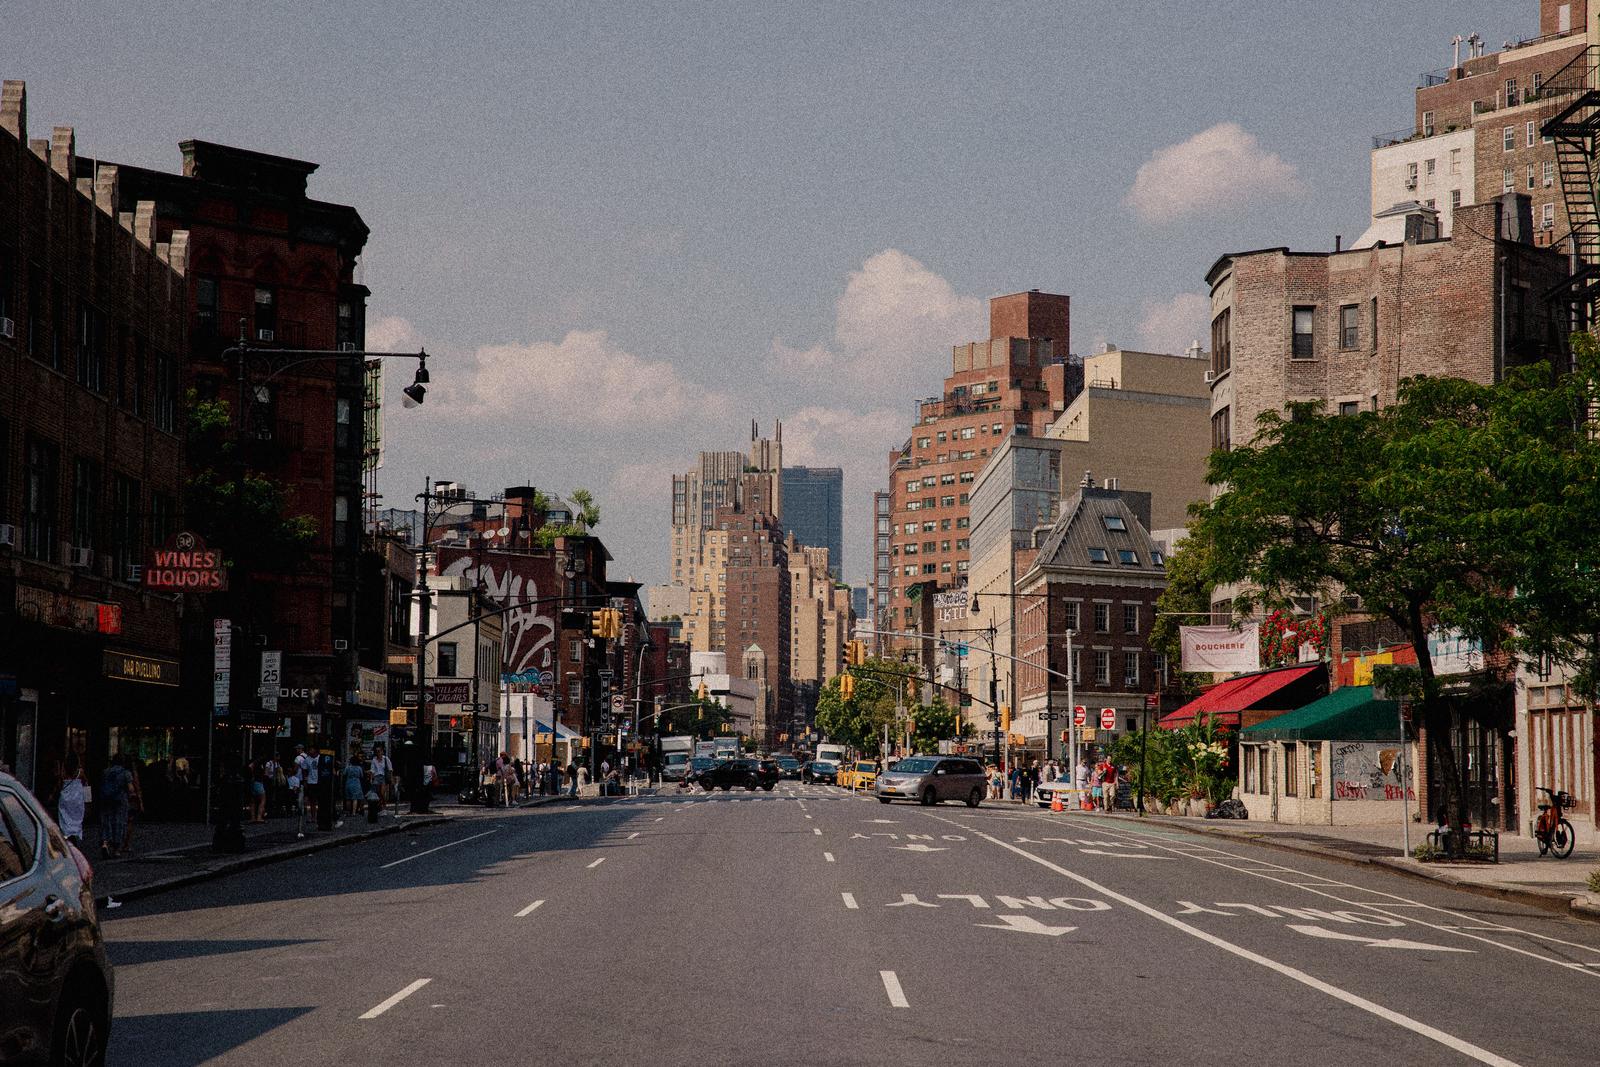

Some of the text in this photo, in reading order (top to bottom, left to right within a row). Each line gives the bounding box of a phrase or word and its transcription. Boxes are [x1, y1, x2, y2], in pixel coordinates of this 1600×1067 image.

[155, 551, 215, 568] WINES
[147, 569, 220, 587] LIQUORS
[1195, 643, 1245, 651] BOUCHERIE
[263, 670, 278, 682] 25
[436, 693, 468, 702] CIGARS
[847, 832, 967, 841] ONLY
[1013, 836, 1149, 849] ONLY
[887, 893, 1113, 911] ONLY
[1174, 900, 1405, 926] ONLY
